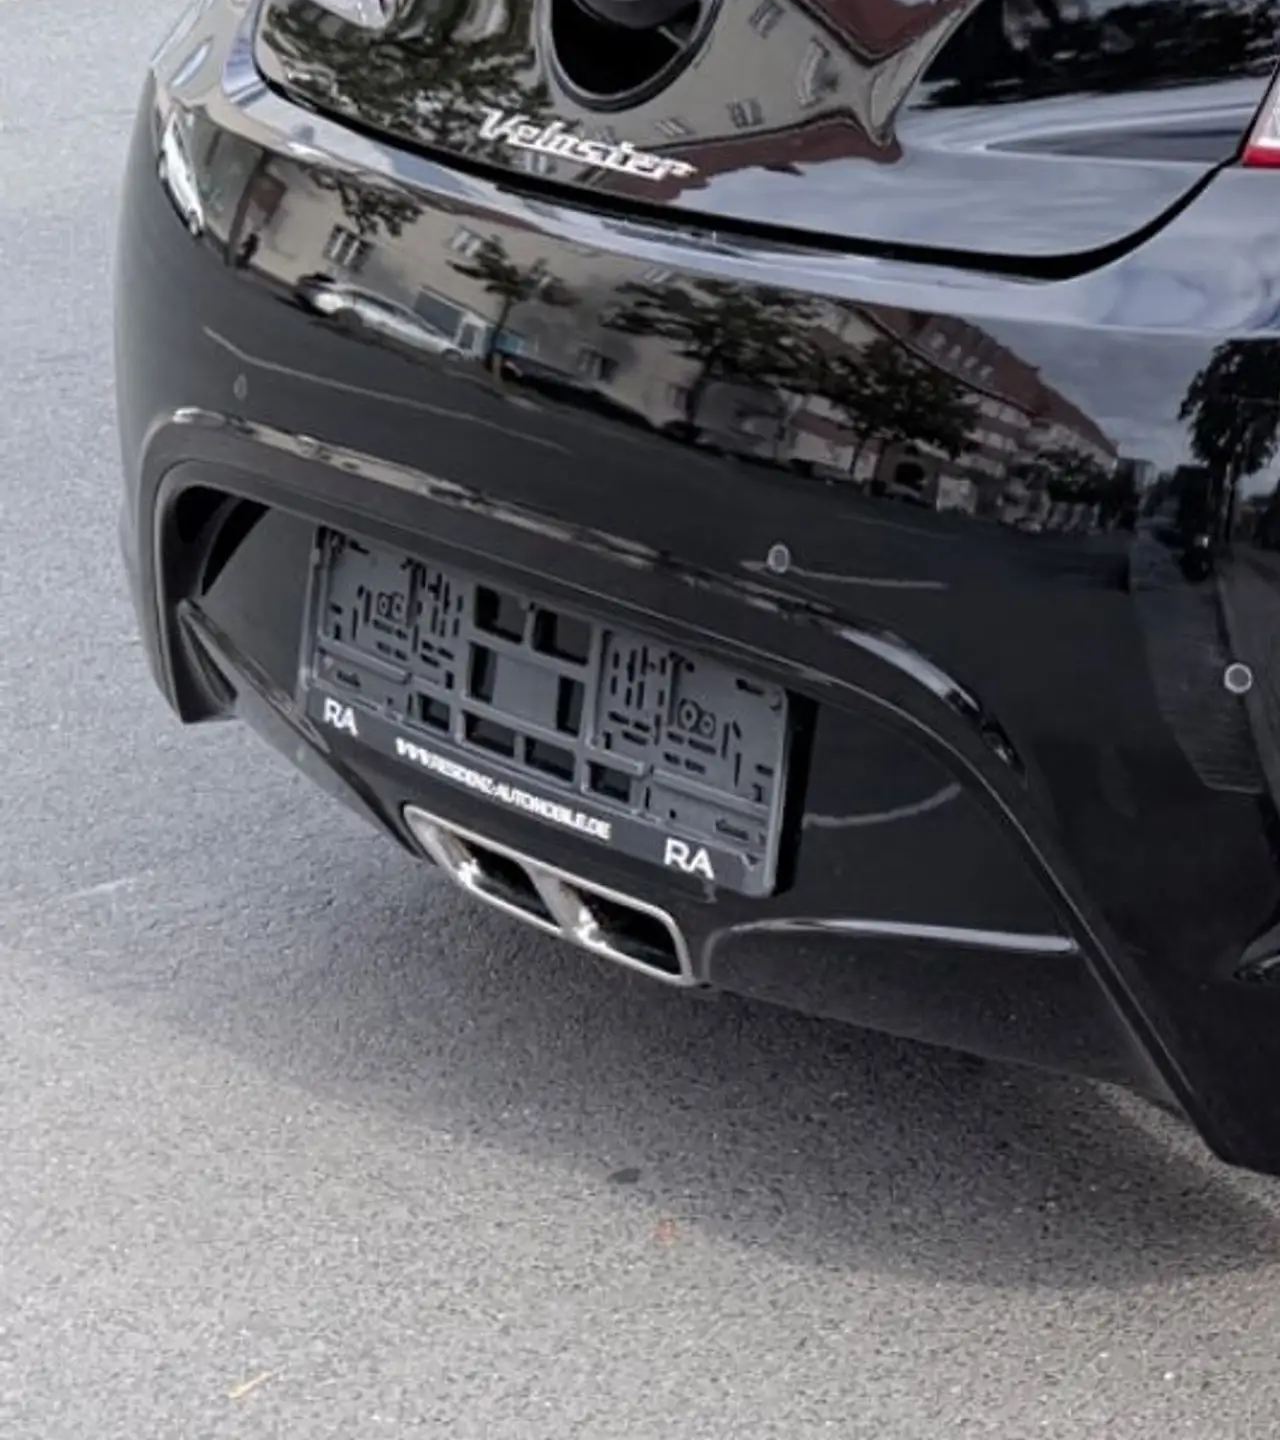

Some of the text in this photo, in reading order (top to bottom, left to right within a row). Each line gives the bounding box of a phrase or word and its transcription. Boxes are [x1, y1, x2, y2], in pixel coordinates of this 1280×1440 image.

[478, 106, 698, 182] Veloster
[323, 696, 359, 738] RA
[664, 837, 715, 880] RA
